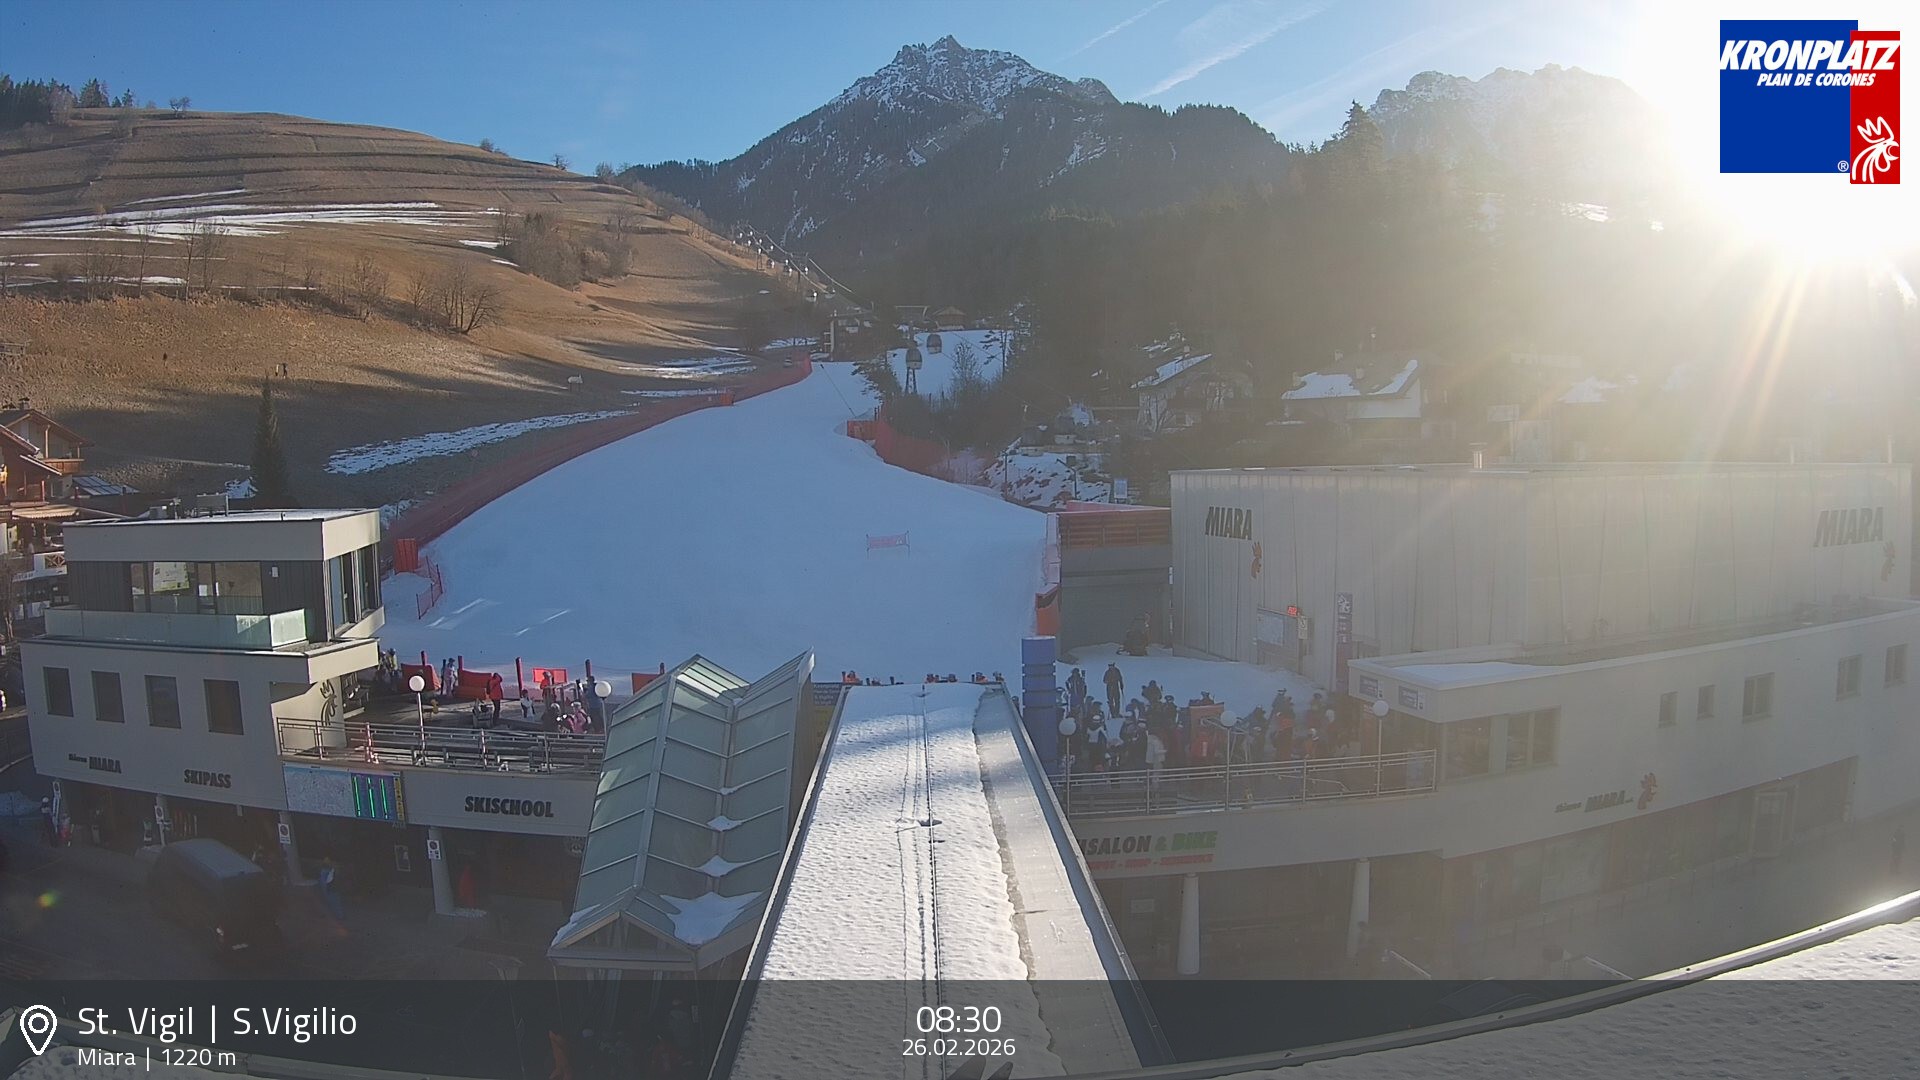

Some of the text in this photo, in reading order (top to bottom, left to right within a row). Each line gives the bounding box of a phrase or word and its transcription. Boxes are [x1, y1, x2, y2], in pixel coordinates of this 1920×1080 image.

[1204, 505, 1252, 541] MIARA
[1813, 506, 1884, 548] MIARA
[183, 768, 232, 789] SKIPASS
[464, 796, 554, 817] SKISCHOOL
